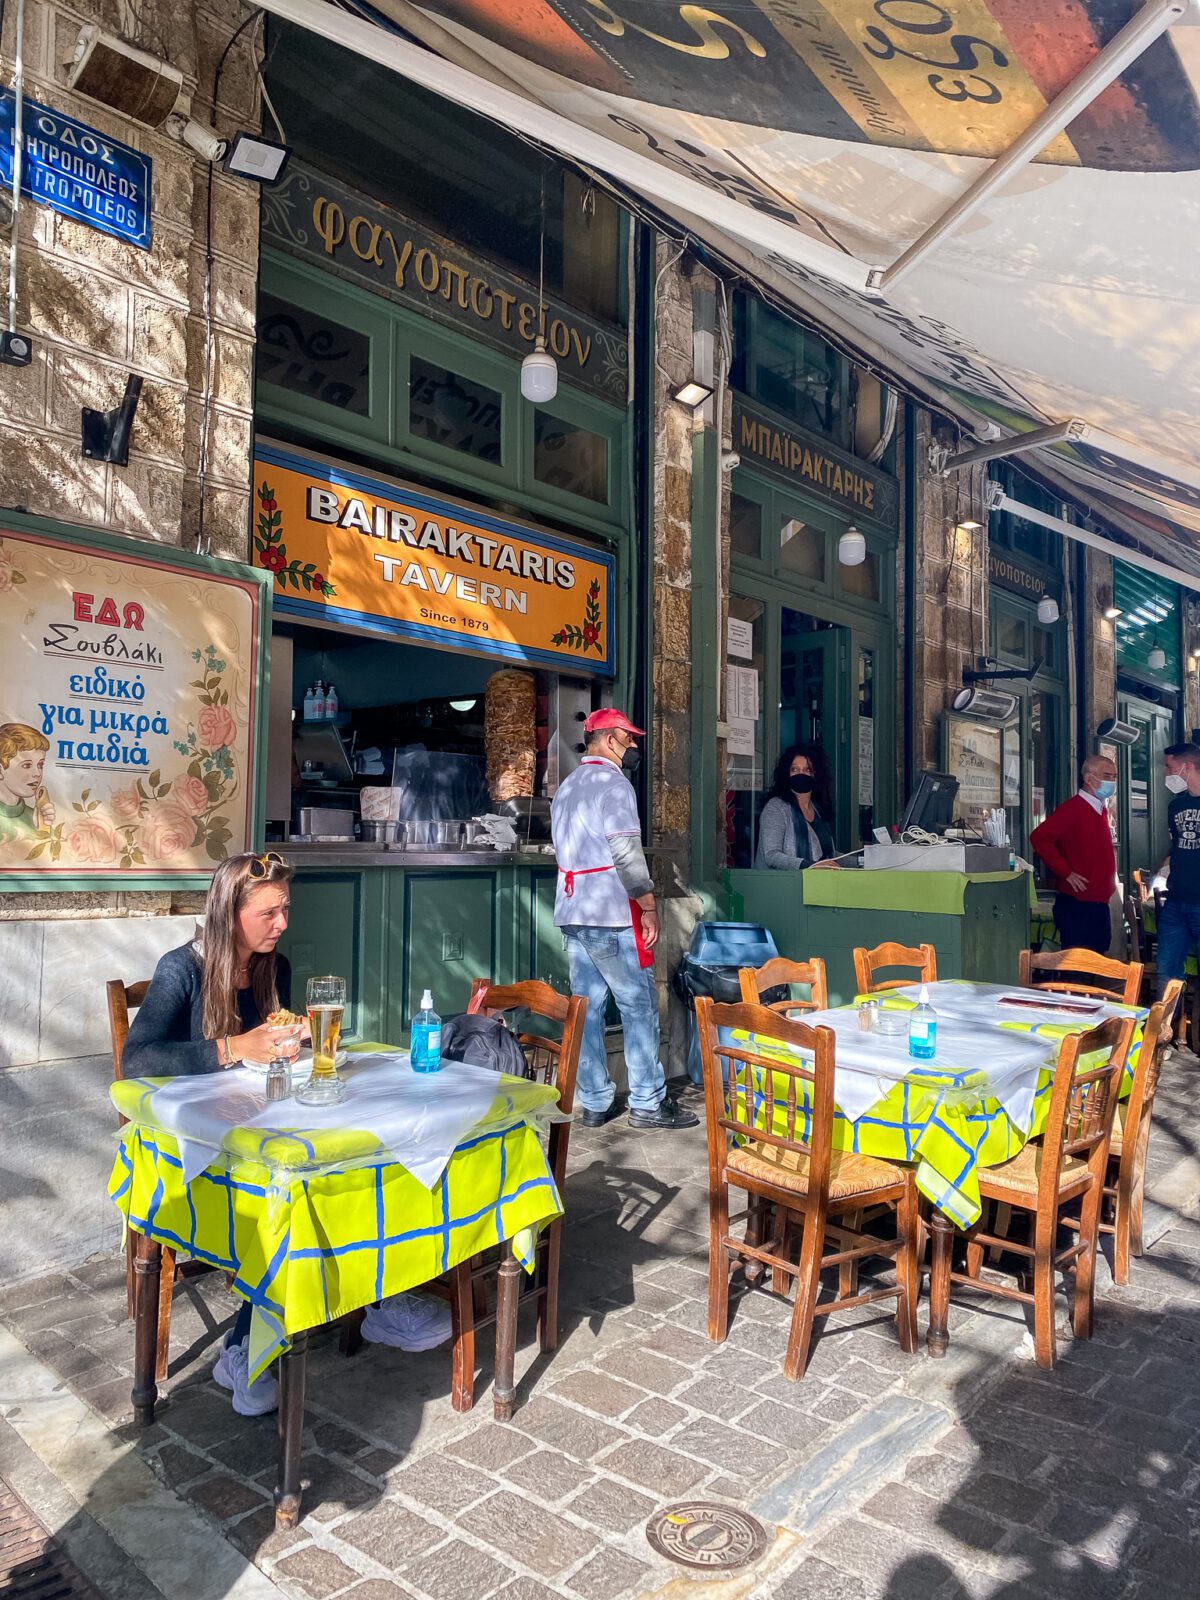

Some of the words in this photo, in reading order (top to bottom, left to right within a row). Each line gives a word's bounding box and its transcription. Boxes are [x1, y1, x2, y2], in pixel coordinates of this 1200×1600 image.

[810, 39, 906, 137] Premium
[38, 116, 114, 165] ΟΔΟΣ
[9, 155, 137, 229] TROPOLEOS
[741, 415, 875, 511] ΜΠΑΪΡΑΚΤΑΡΗΣ
[306, 486, 576, 591] BAIRAKTARIS
[374, 553, 528, 615] TAVERN
[72, 591, 146, 632] ΕΔΩ
[420, 607, 457, 625] Since
[461, 616, 490, 632] 1879
[43, 623, 163, 664] Σουβλάκι
[69, 666, 146, 701] ειδικό
[38, 703, 85, 736] για
[88, 709, 170, 739] μικρά
[57, 733, 150, 766] παιδιά
